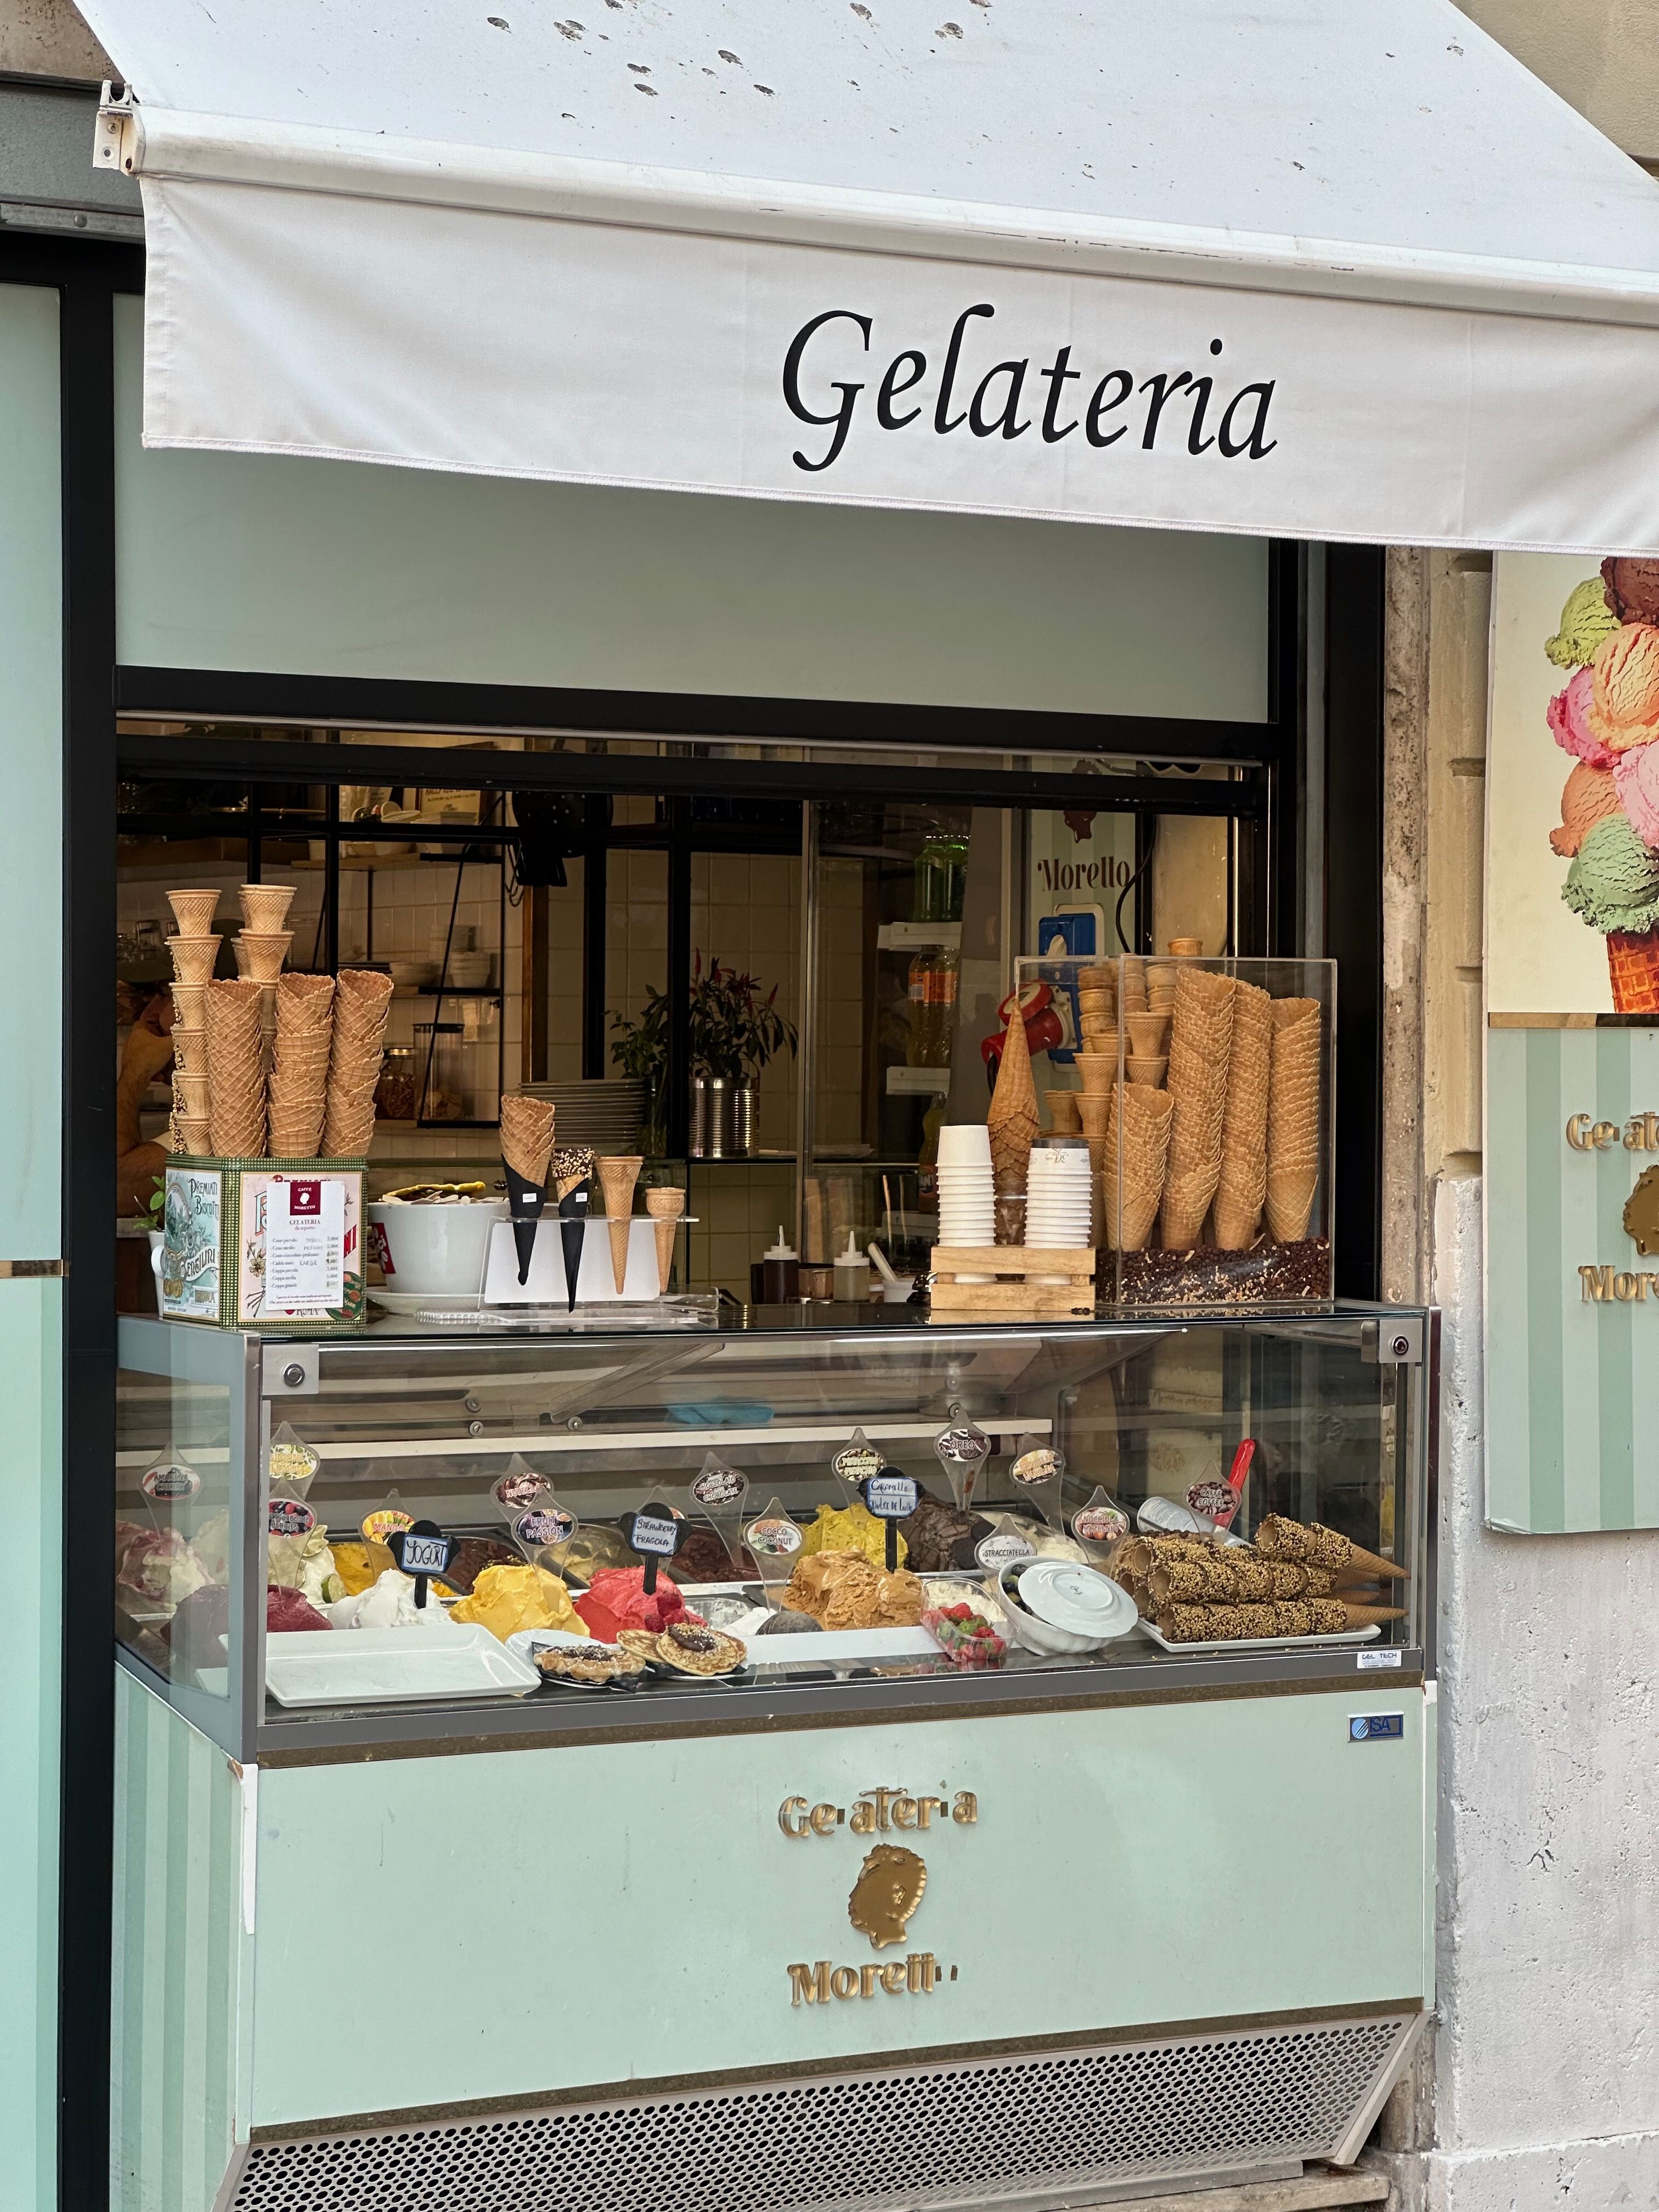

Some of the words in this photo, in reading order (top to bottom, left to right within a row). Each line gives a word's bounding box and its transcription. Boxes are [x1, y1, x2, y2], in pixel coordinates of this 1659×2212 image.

[783, 303, 1277, 472] Gelateria
[1037, 856, 1130, 891] Moretto
[1566, 1110, 1659, 1151] Geat
[188, 1178, 218, 1198] PREMIATI
[950, 1440, 975, 1449] OREO
[154, 1474, 188, 1482] AMARENA
[699, 1475, 736, 1491] CIOCCOLATO
[157, 1482, 185, 1491] CHERRY
[703, 1487, 740, 1502] CHOCOLATE
[1198, 1498, 1224, 1507] COFFEE
[531, 1516, 555, 1527] FRUIT
[1082, 1515, 1118, 1523] NOCCIOLA
[271, 1520, 299, 1532] BERRIES
[374, 1523, 405, 1532] MANGO
[526, 1525, 564, 1538] PASSION
[637, 1519, 676, 1536] STRAWBERRY
[761, 1527, 787, 1536] COCCO
[1083, 1525, 1119, 1533] HAZELNUT
[634, 1534, 669, 1547] FRAGOLA
[758, 1537, 793, 1546] COCONUT
[406, 1540, 448, 1566] YOGURT
[1369, 1717, 1391, 1732] ISA
[778, 1786, 978, 1837] Geatera
[787, 1951, 958, 2006] Morett
